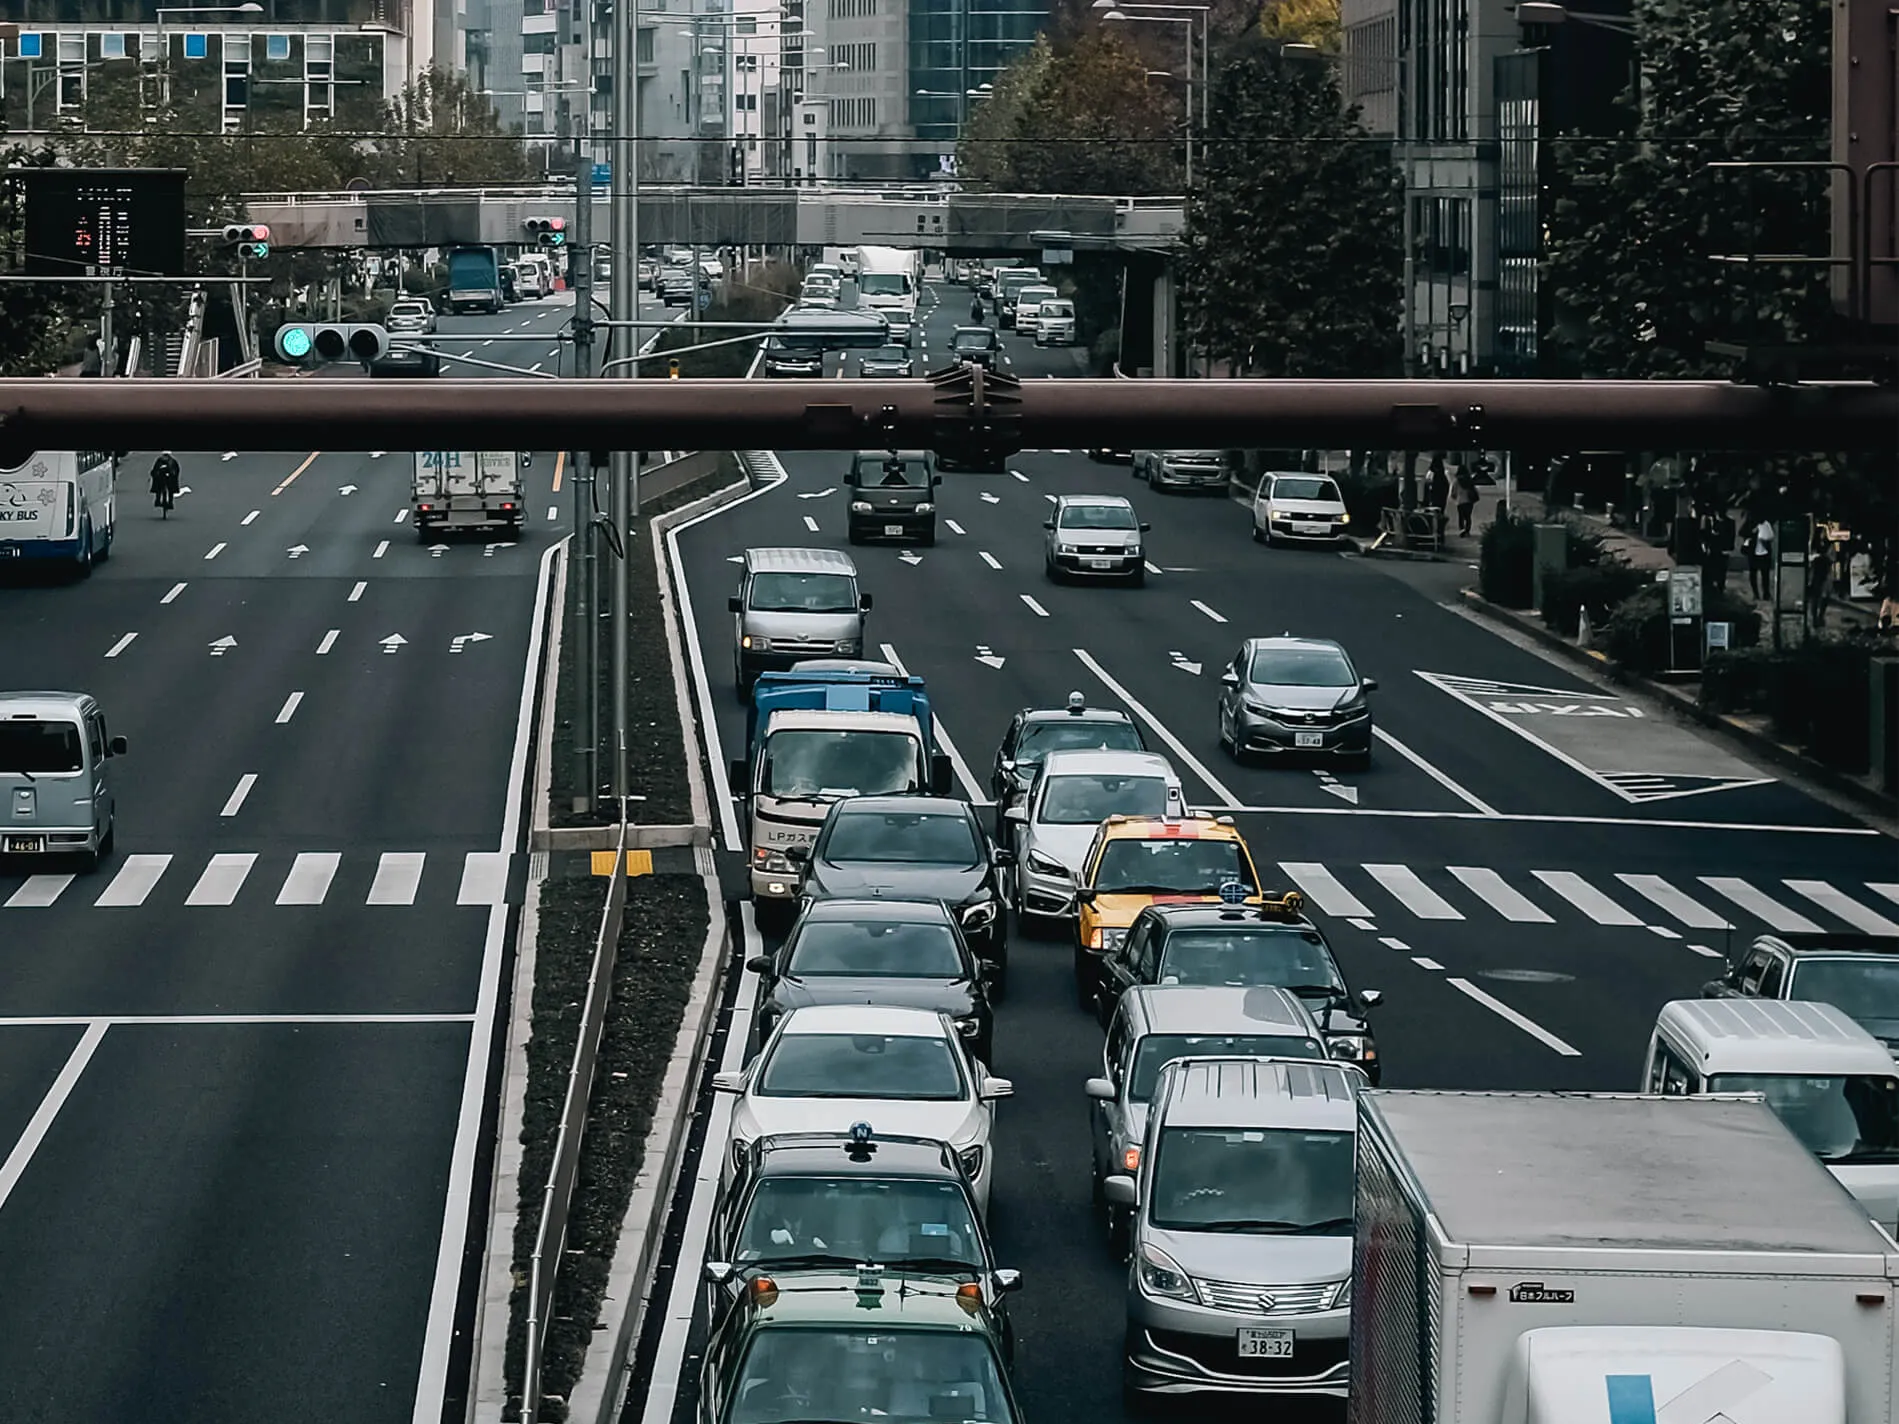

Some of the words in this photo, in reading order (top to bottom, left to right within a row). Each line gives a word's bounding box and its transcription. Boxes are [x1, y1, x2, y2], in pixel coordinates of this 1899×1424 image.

[17, 510, 38, 521] BUS
[856, 1127, 868, 1138] N
[1250, 1340, 1292, 1355] 38-32
